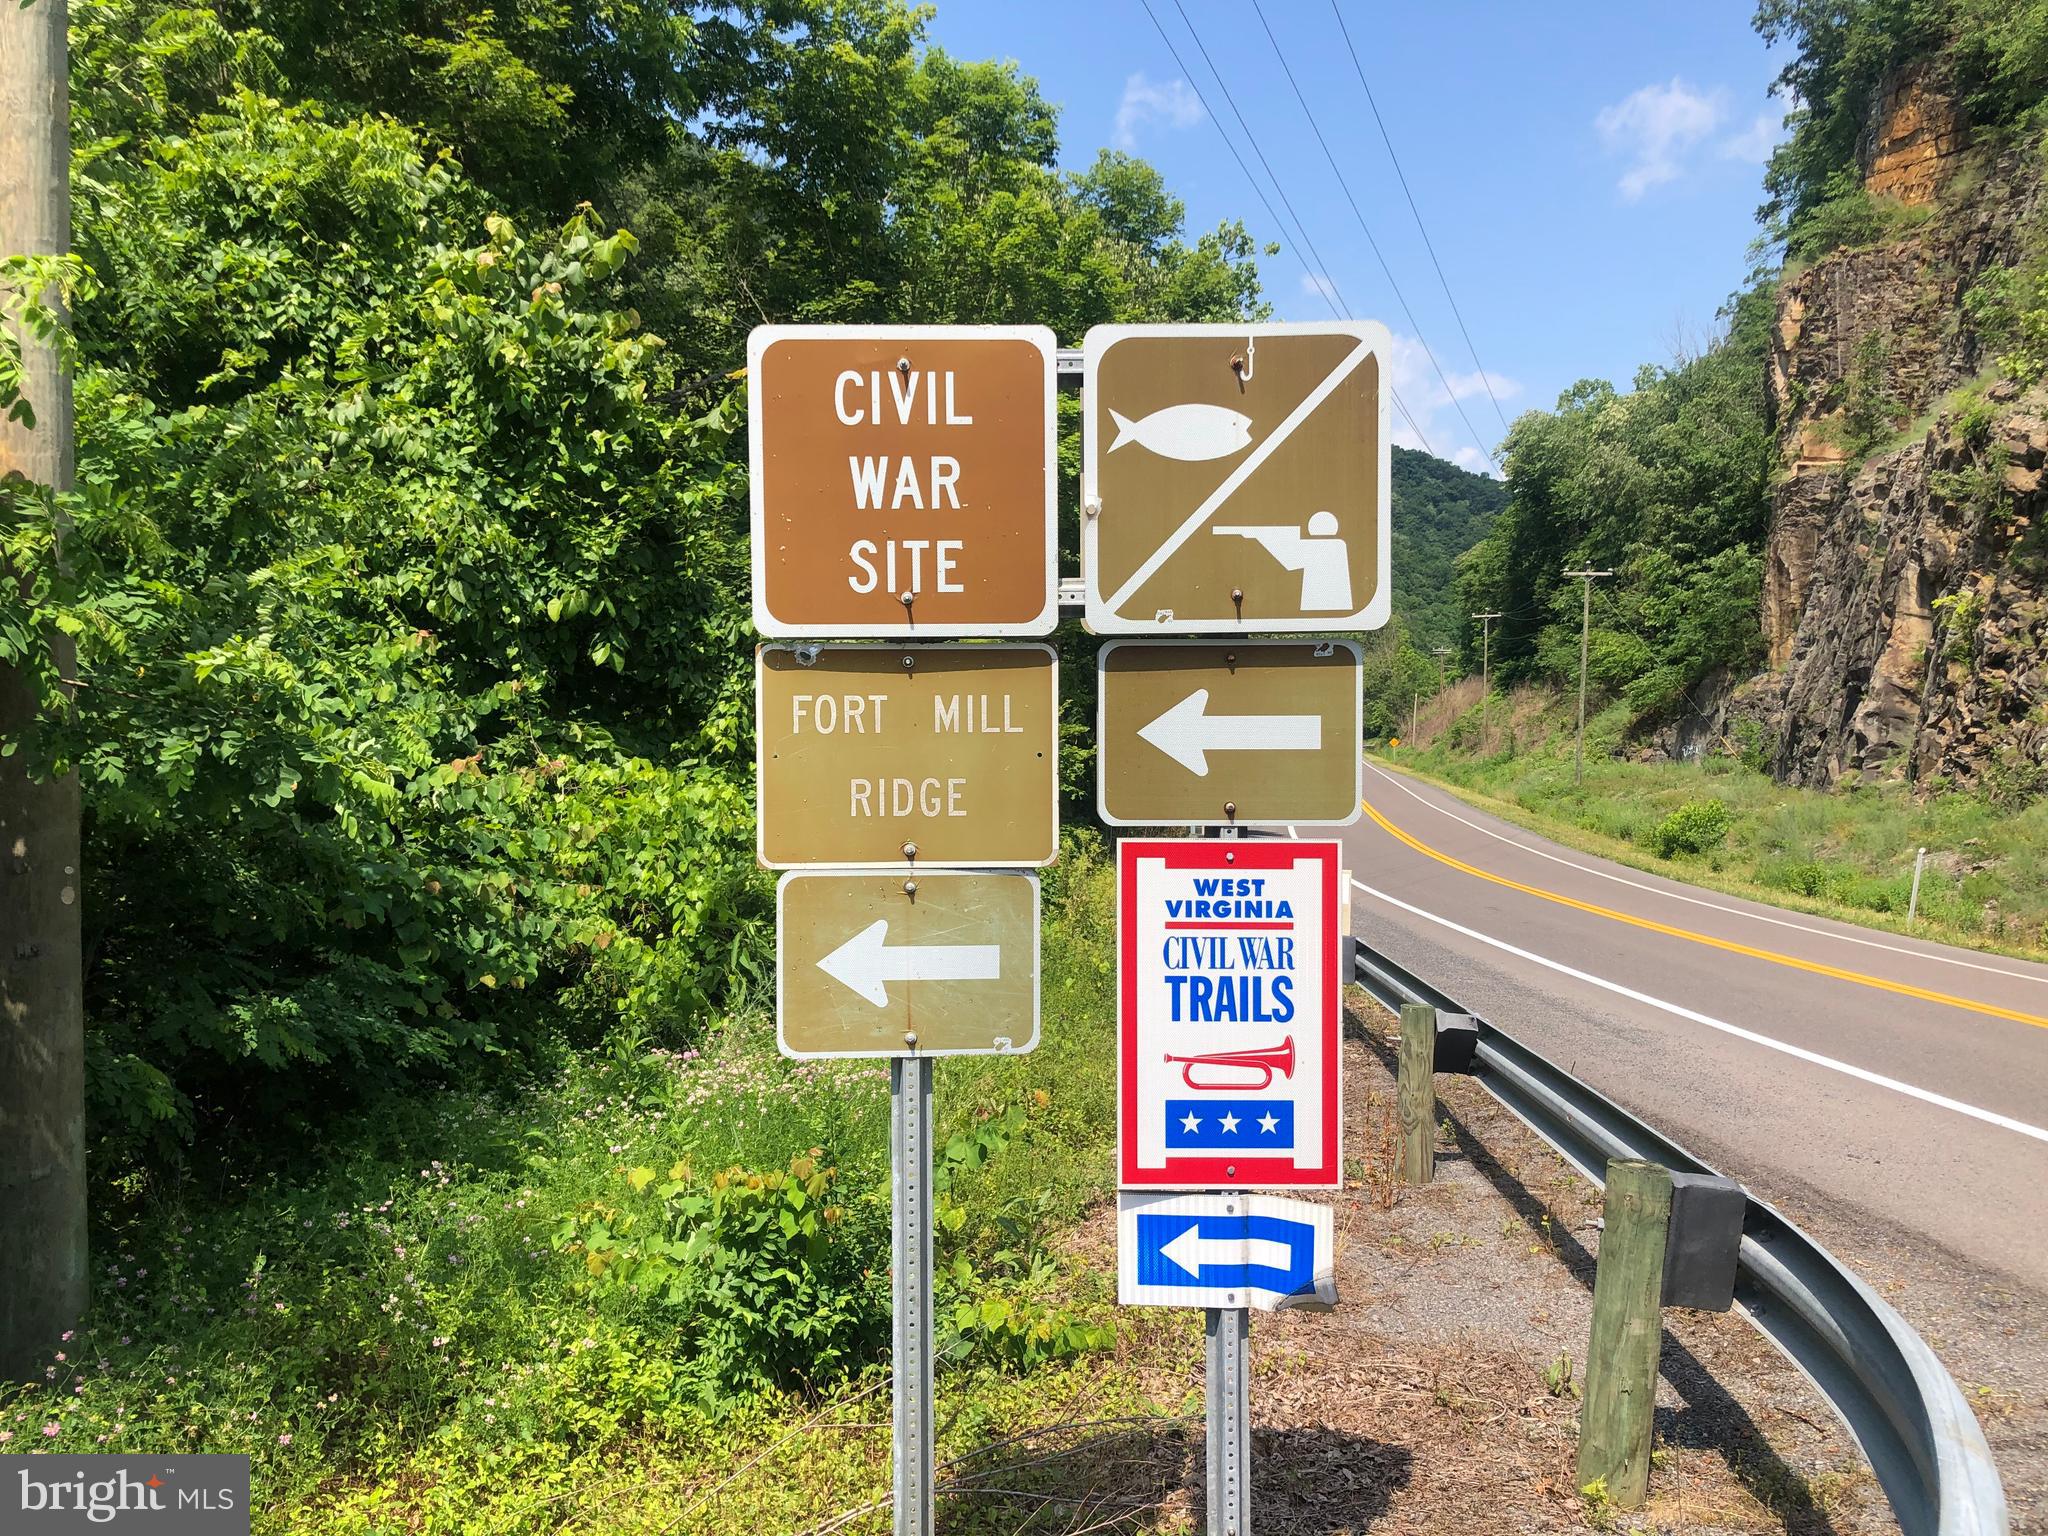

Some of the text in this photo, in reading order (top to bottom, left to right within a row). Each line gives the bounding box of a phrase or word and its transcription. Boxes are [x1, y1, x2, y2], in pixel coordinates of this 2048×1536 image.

[834, 370, 973, 425] CIVIL
[849, 456, 961, 509] WAR
[848, 540, 964, 593] SITE
[792, 694, 1024, 734] FORT MILL
[850, 778, 967, 817] RIDGE
[1193, 878, 1265, 897] WEST
[1165, 900, 1294, 918] VIRGINIA
[1163, 936, 1295, 970] CIVIL WAR
[1164, 975, 1295, 1022] TRAILS
